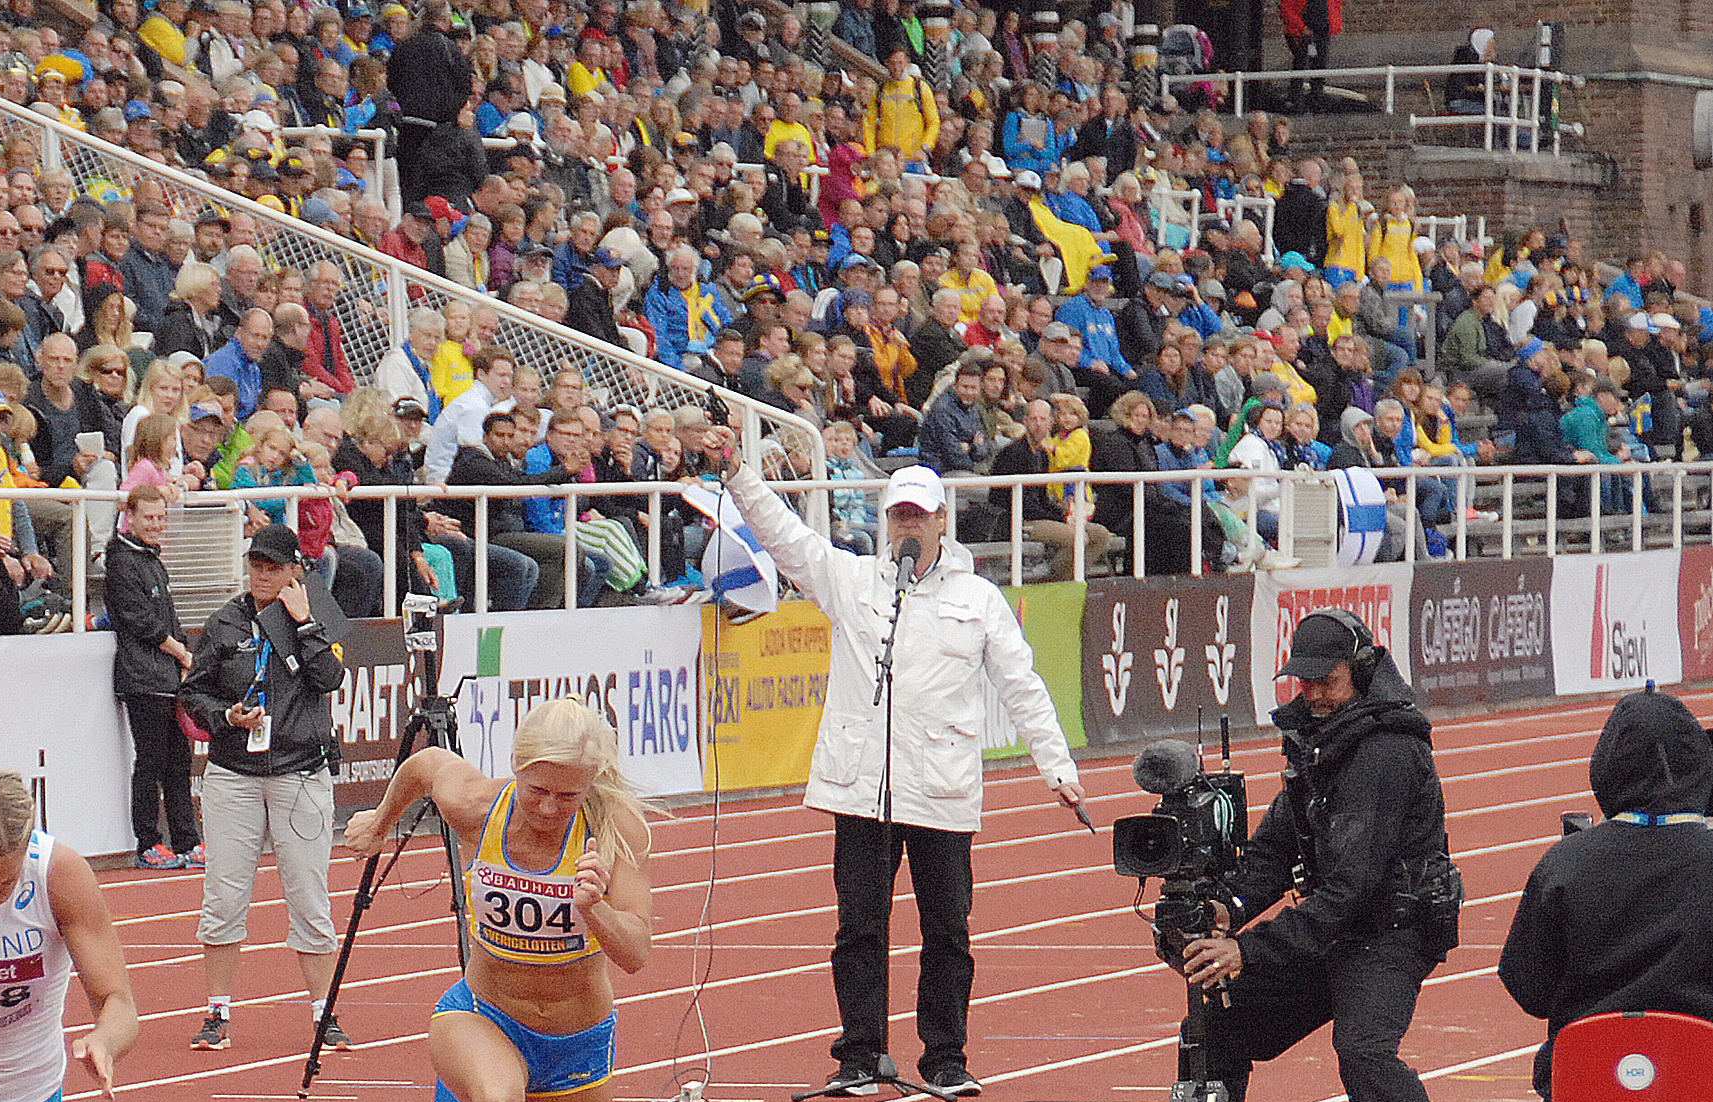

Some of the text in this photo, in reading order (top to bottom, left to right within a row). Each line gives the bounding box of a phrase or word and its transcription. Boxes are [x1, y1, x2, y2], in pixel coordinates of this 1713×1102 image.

[1611, 619, 1649, 680] Sievi
[330, 664, 405, 743] RAFT
[628, 650, 689, 757] FÄRG
[484, 890, 576, 934] 304
[493, 874, 570, 898] BAUHAU
